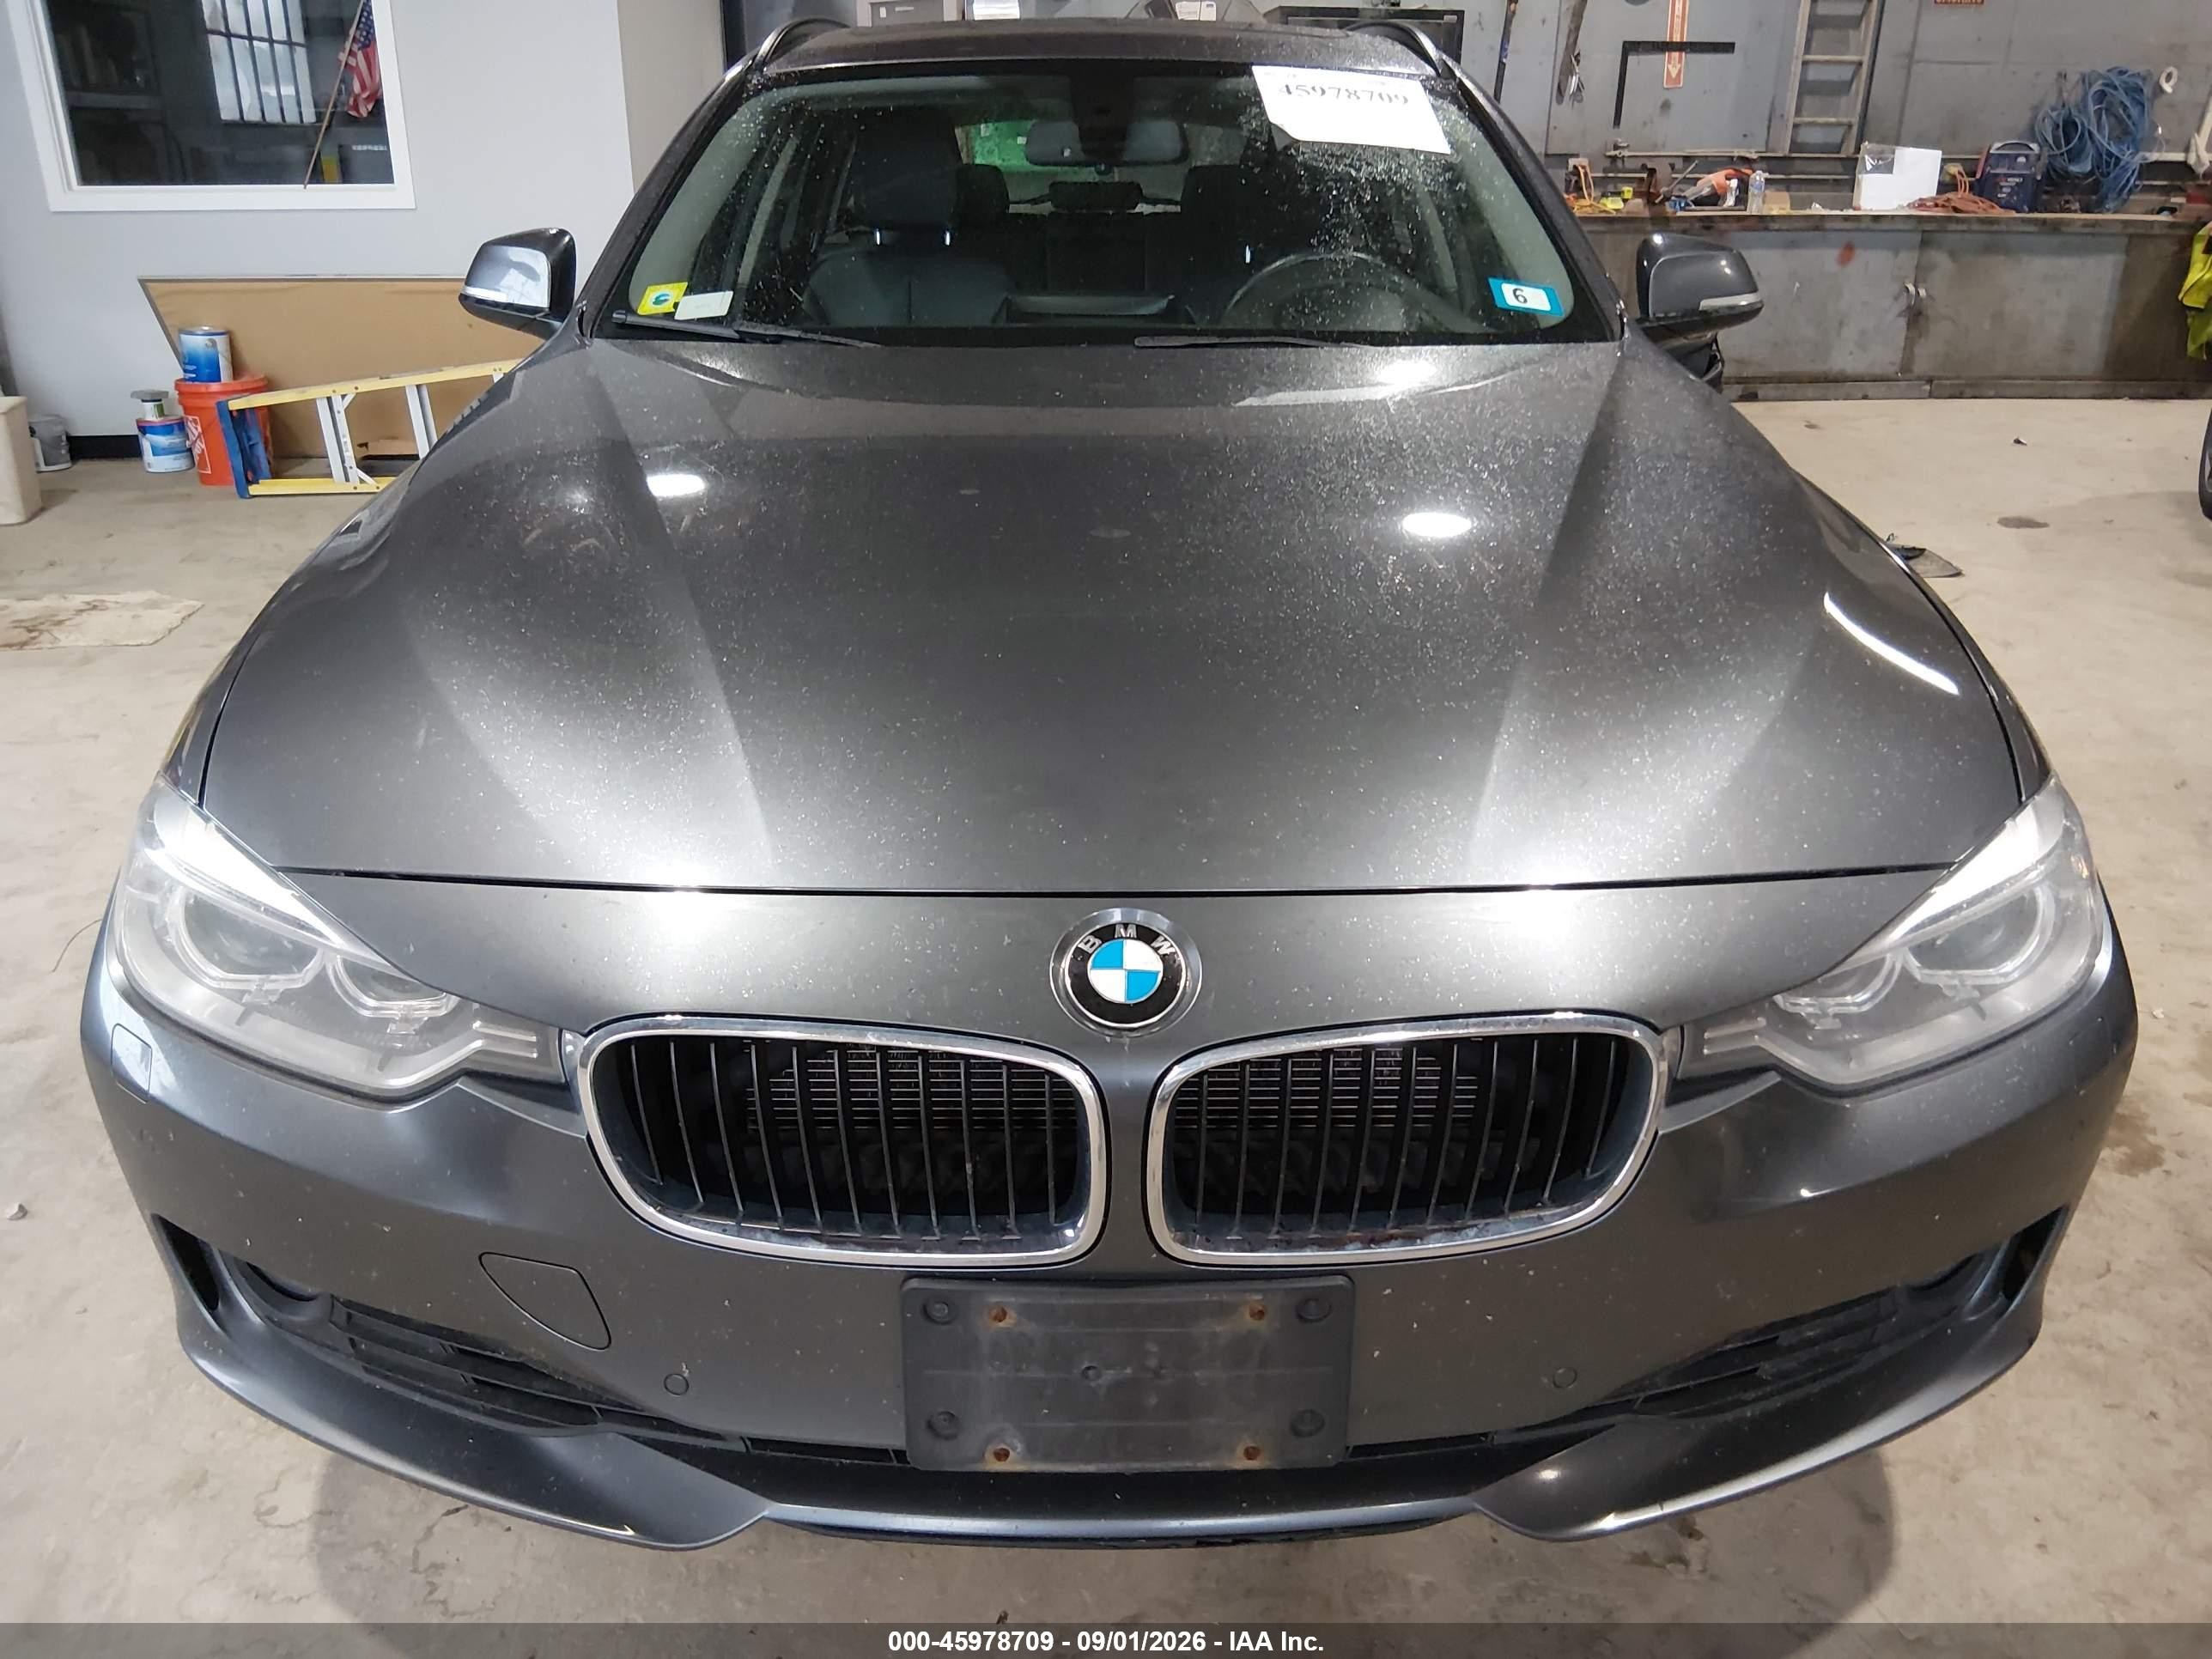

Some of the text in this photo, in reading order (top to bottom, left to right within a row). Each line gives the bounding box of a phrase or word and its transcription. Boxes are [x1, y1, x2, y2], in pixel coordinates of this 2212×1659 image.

[1279, 83, 1409, 105] 45978709
[1512, 288, 1528, 304] 6
[1078, 924, 1176, 956] BMW
